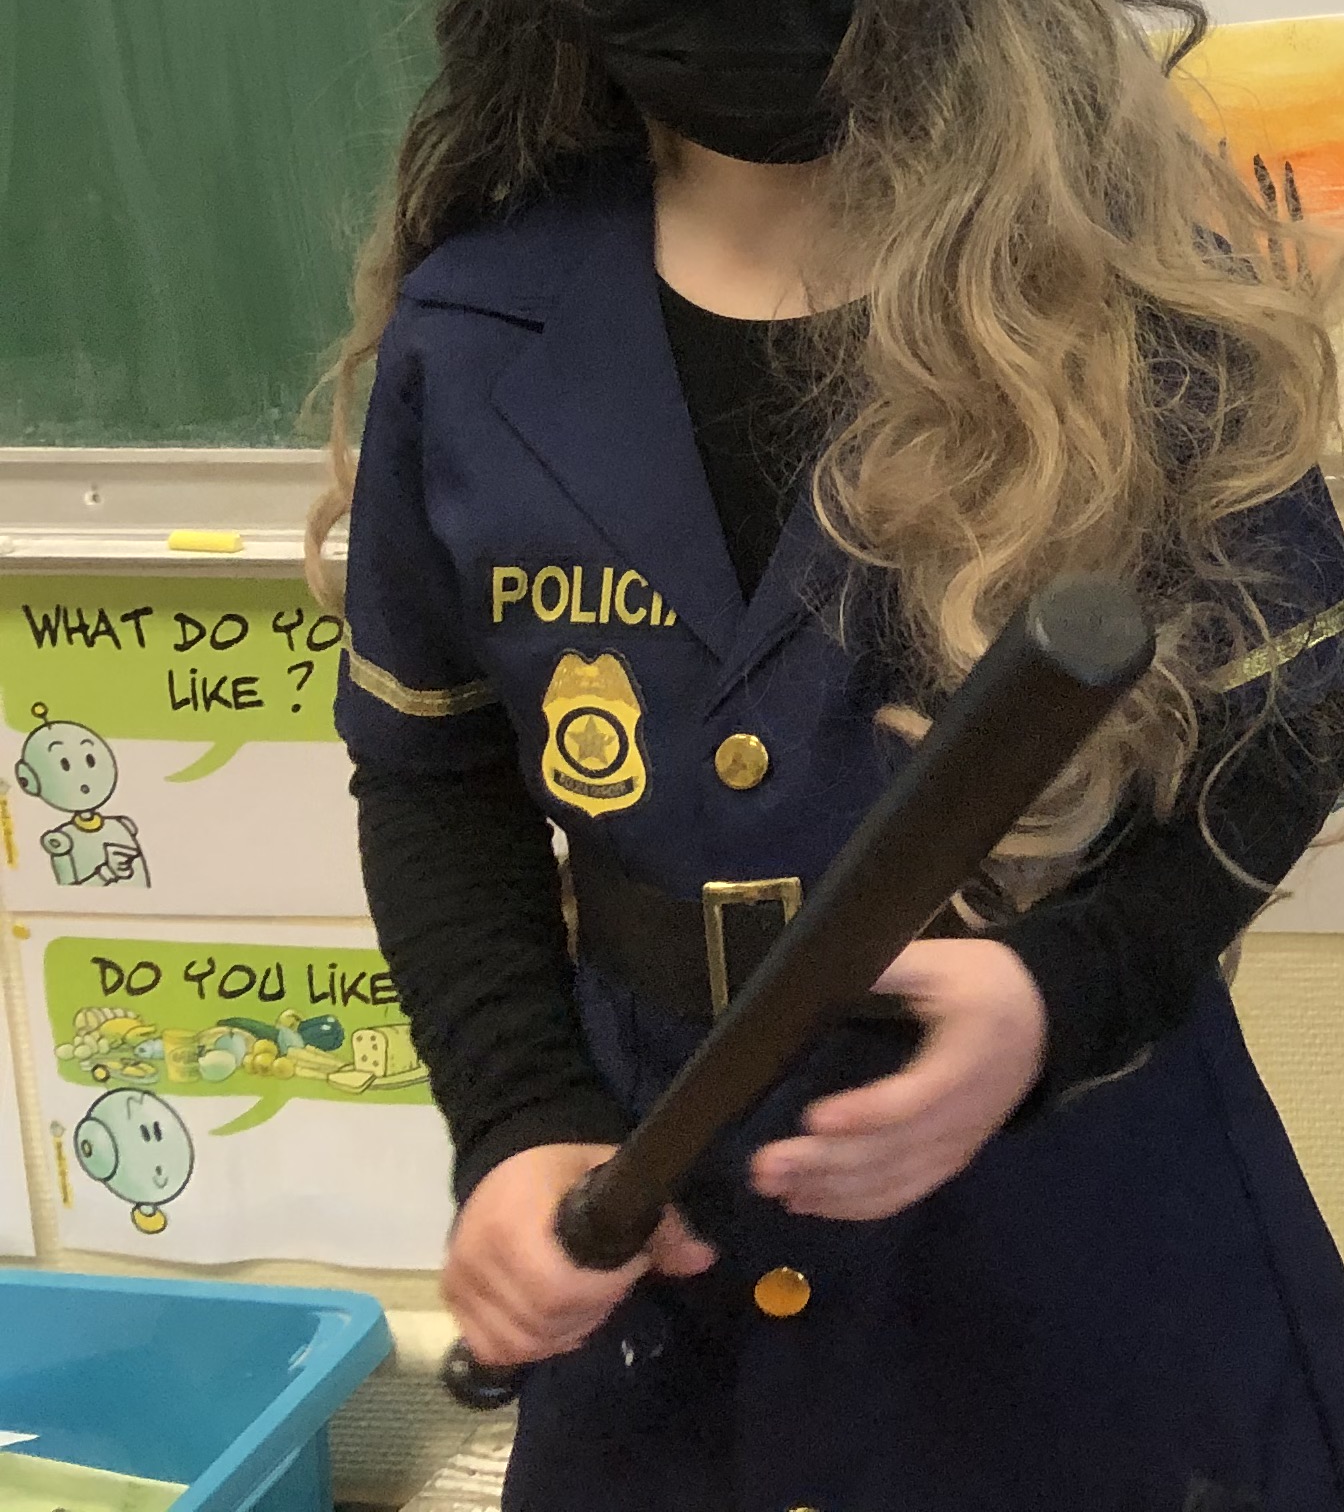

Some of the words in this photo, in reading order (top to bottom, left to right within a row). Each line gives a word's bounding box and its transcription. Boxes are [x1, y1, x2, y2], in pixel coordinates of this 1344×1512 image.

[492, 565, 678, 627] POLICI
[22, 603, 154, 651] WHAT
[172, 612, 250, 653] DO
[272, 607, 345, 652] YO
[287, 660, 315, 714] ?
[92, 956, 162, 998] DO
[184, 961, 287, 1001] YOU
